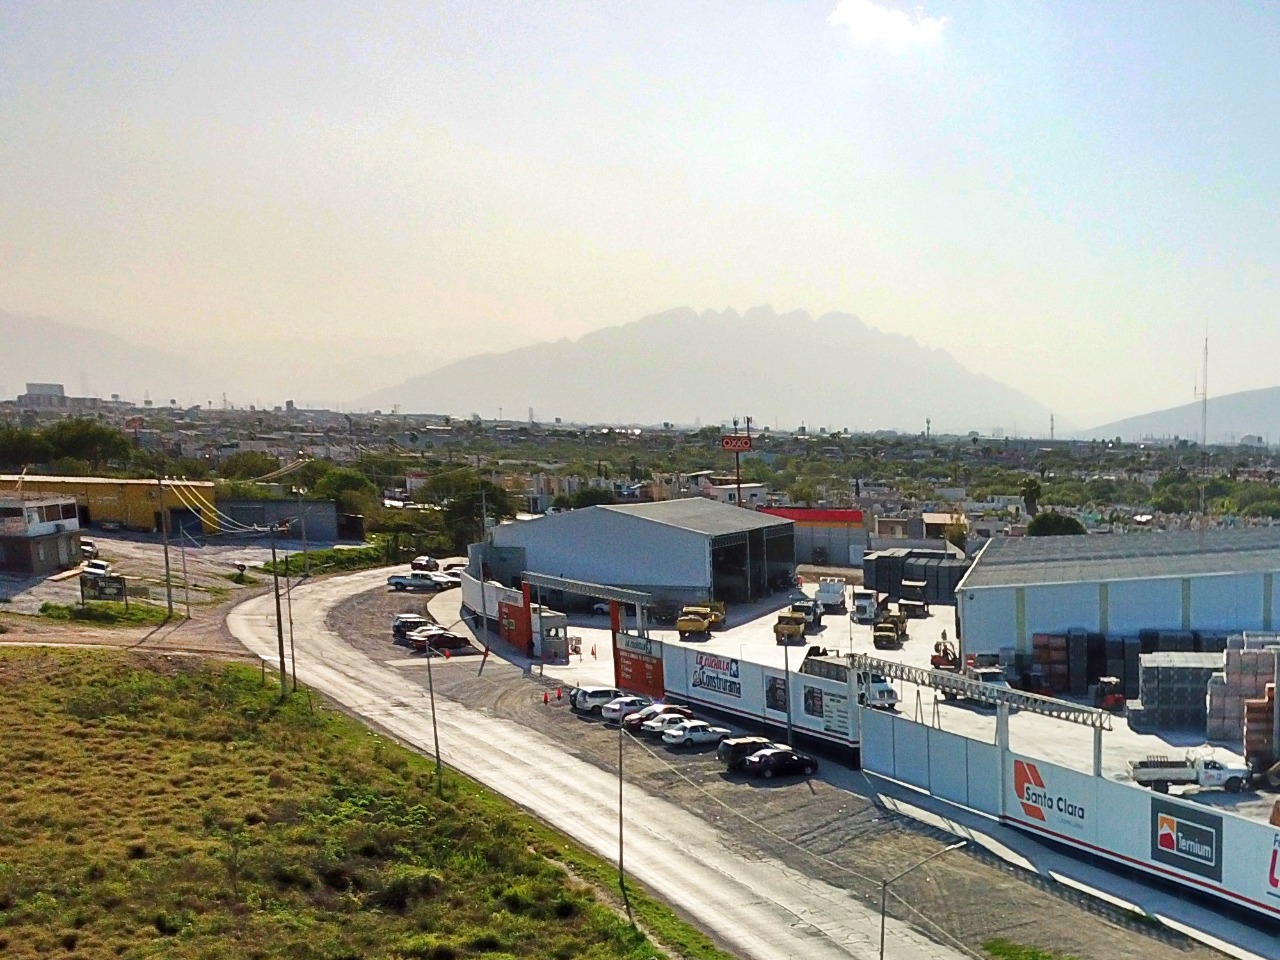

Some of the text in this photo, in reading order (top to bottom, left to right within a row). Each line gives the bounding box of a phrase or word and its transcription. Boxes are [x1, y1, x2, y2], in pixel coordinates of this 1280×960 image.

[723, 438, 751, 448] OXXO
[696, 654, 704, 666] LA
[701, 670, 742, 696] Construrama
[1025, 786, 1085, 820] Santa Clara
[1177, 832, 1212, 859] Ternium
